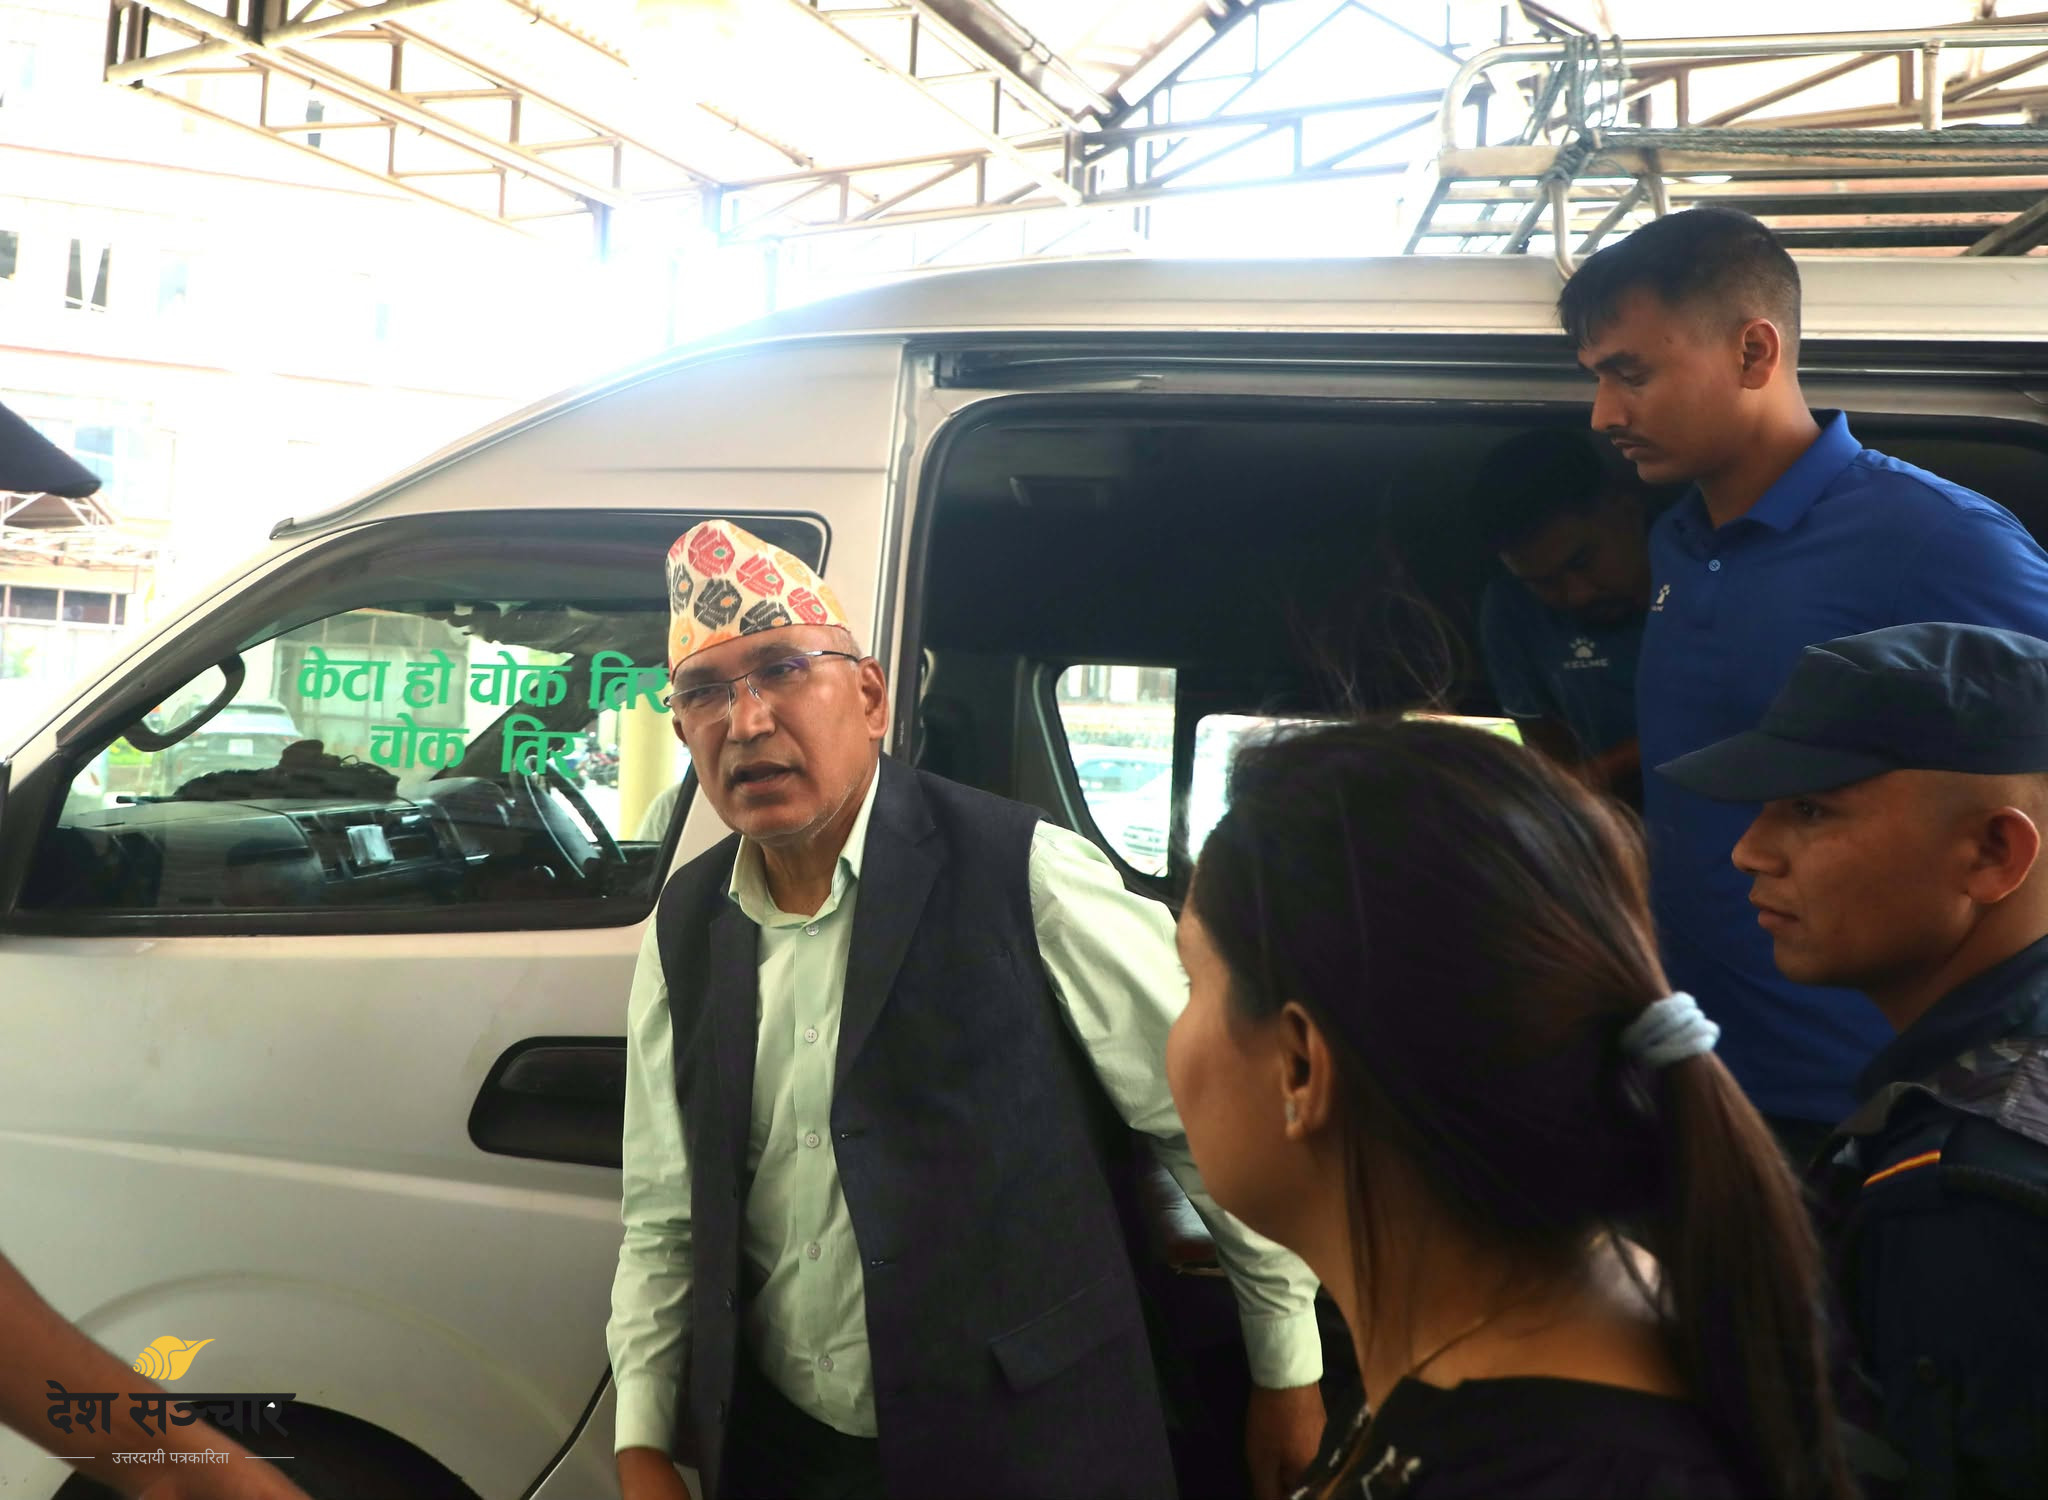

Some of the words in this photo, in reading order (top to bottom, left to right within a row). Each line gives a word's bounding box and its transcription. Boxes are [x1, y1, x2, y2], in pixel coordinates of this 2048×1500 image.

[299, 646, 392, 703] केटा
[401, 649, 456, 710] हो
[470, 651, 573, 708] चोक
[370, 713, 470, 770] चोक
[502, 714, 587, 778] तिर
